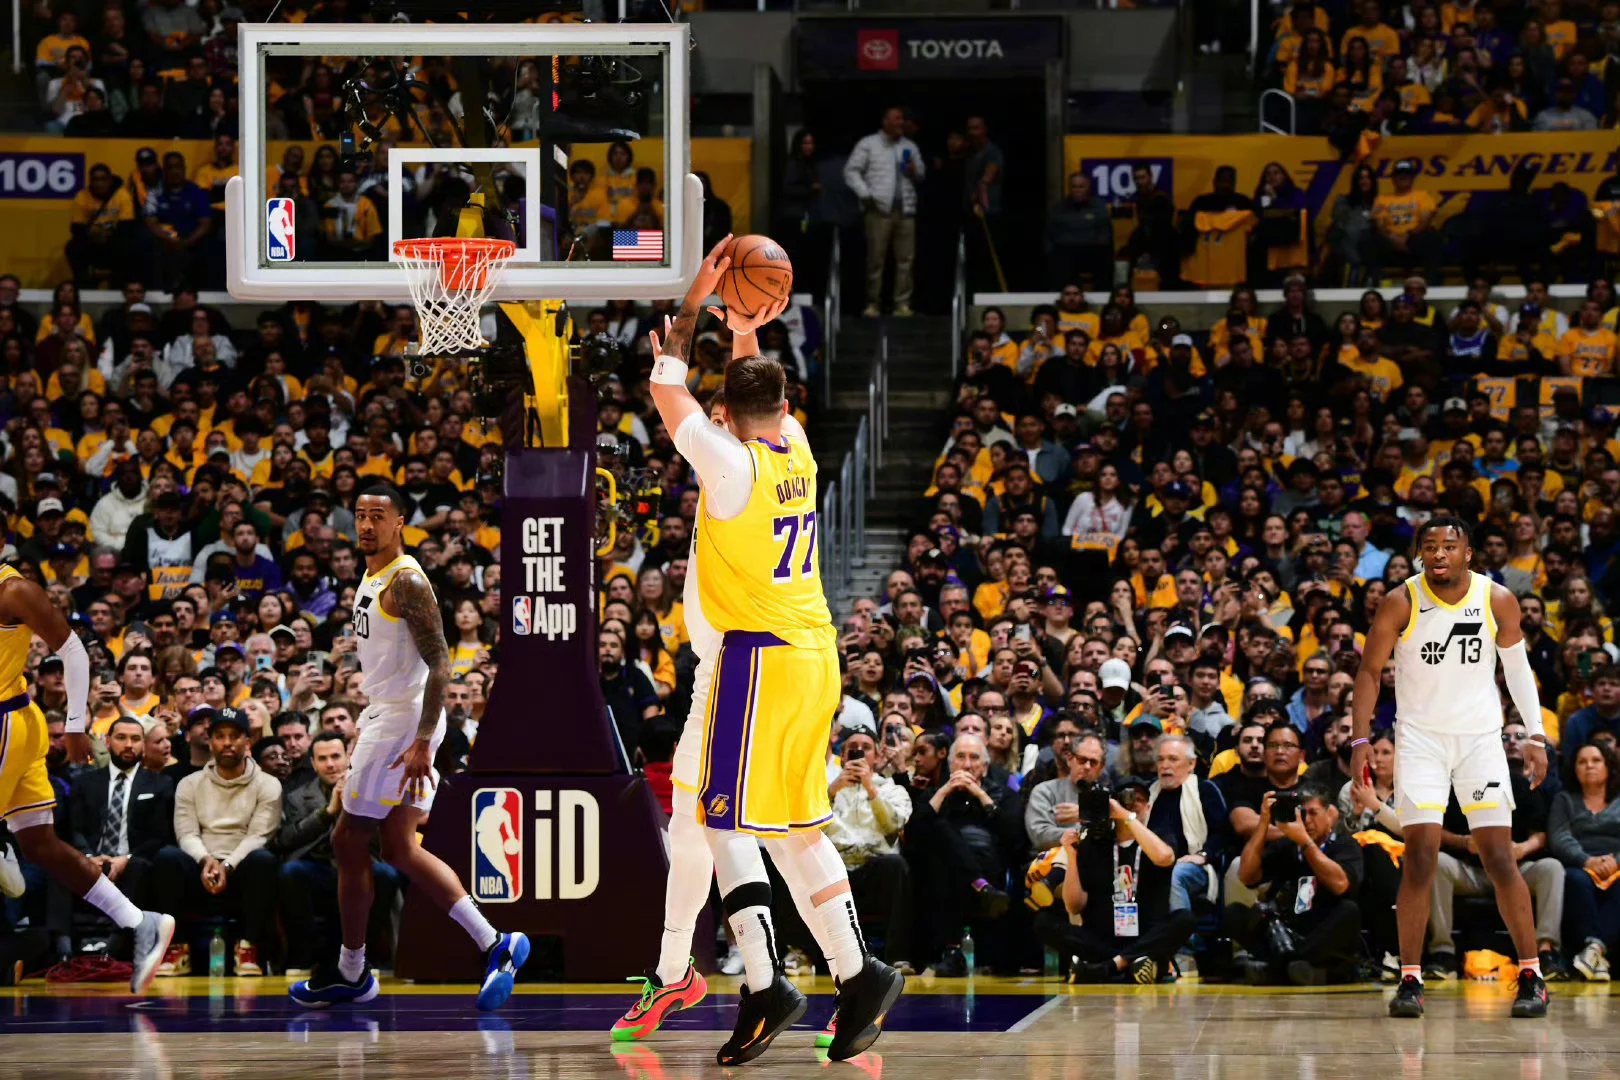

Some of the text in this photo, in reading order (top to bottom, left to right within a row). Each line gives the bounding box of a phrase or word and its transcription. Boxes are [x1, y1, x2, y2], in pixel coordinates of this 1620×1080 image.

[906, 39, 1003, 59] TOYOTA
[0, 159, 76, 193] 106
[522, 517, 565, 554] GET
[772, 510, 816, 584] 77
[522, 556, 566, 592] THE
[356, 609, 370, 639] 20
[533, 596, 577, 641] App
[1464, 608, 1480, 616] LVT
[1457, 637, 1482, 664] 13
[535, 789, 600, 900] iD
[479, 876, 504, 895] NBA
